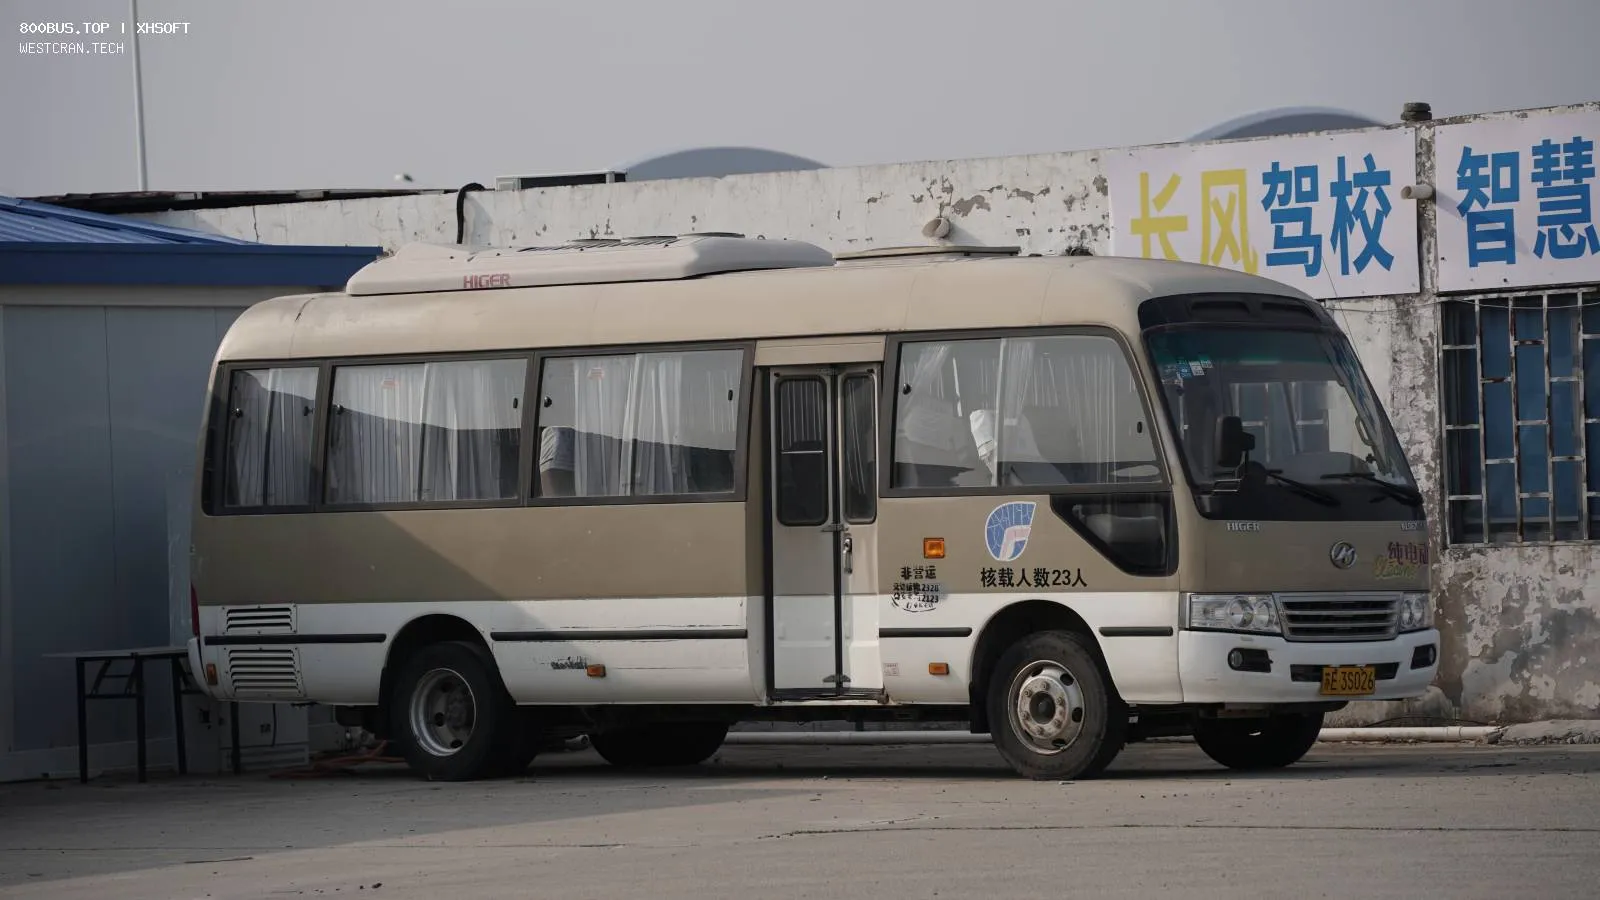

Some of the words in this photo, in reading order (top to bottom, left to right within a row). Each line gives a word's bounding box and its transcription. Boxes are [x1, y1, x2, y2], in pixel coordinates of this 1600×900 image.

[1456, 136, 1600, 268] 智慧
[1130, 153, 1395, 277] 长风驾校
[463, 273, 511, 289] HIGER
[900, 565, 937, 580] 非营运
[980, 567, 1088, 588] 核载人数23人
